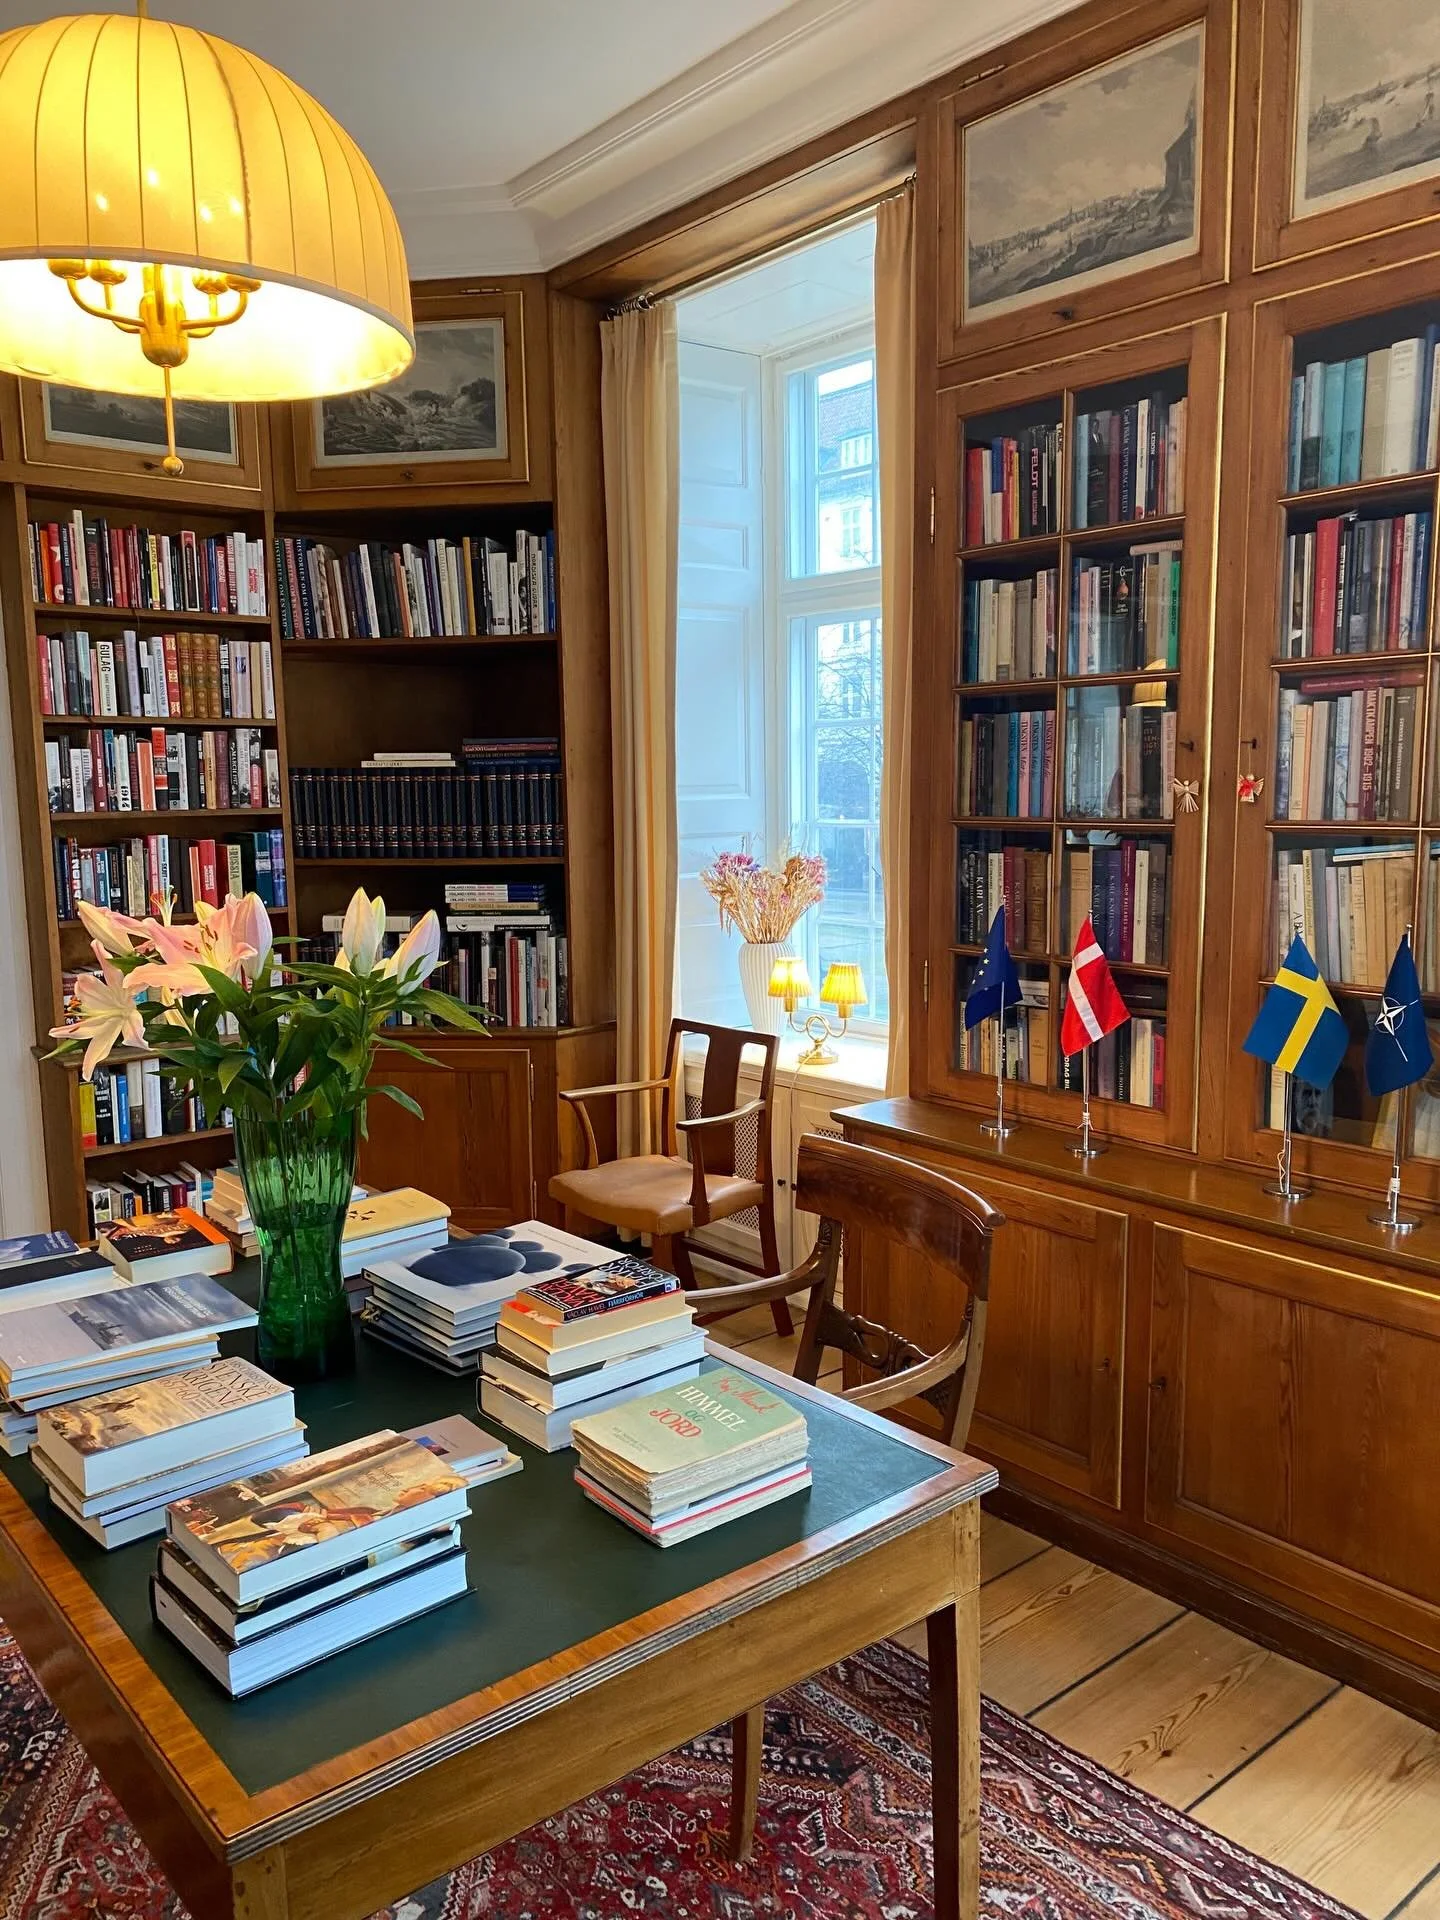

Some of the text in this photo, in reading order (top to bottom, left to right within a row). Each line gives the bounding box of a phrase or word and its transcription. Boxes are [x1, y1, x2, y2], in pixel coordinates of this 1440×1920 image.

[1031, 447, 1039, 488] FELDT
[274, 540, 284, 581] HISTORIEN
[296, 539, 306, 582] HISTORIEN
[300, 583, 307, 595] OM
[99, 643, 111, 672] GULAG
[1364, 689, 1376, 744] MAKTKAMPEN
[229, 850, 240, 880] RUSSIA
[974, 876, 984, 915] KARL XV
[175, 1367, 248, 1408] KRIGENE
[199, 1361, 273, 1401] SVENSKE
[648, 1407, 702, 1439] JORD
[674, 1385, 747, 1433] HIMMEL
